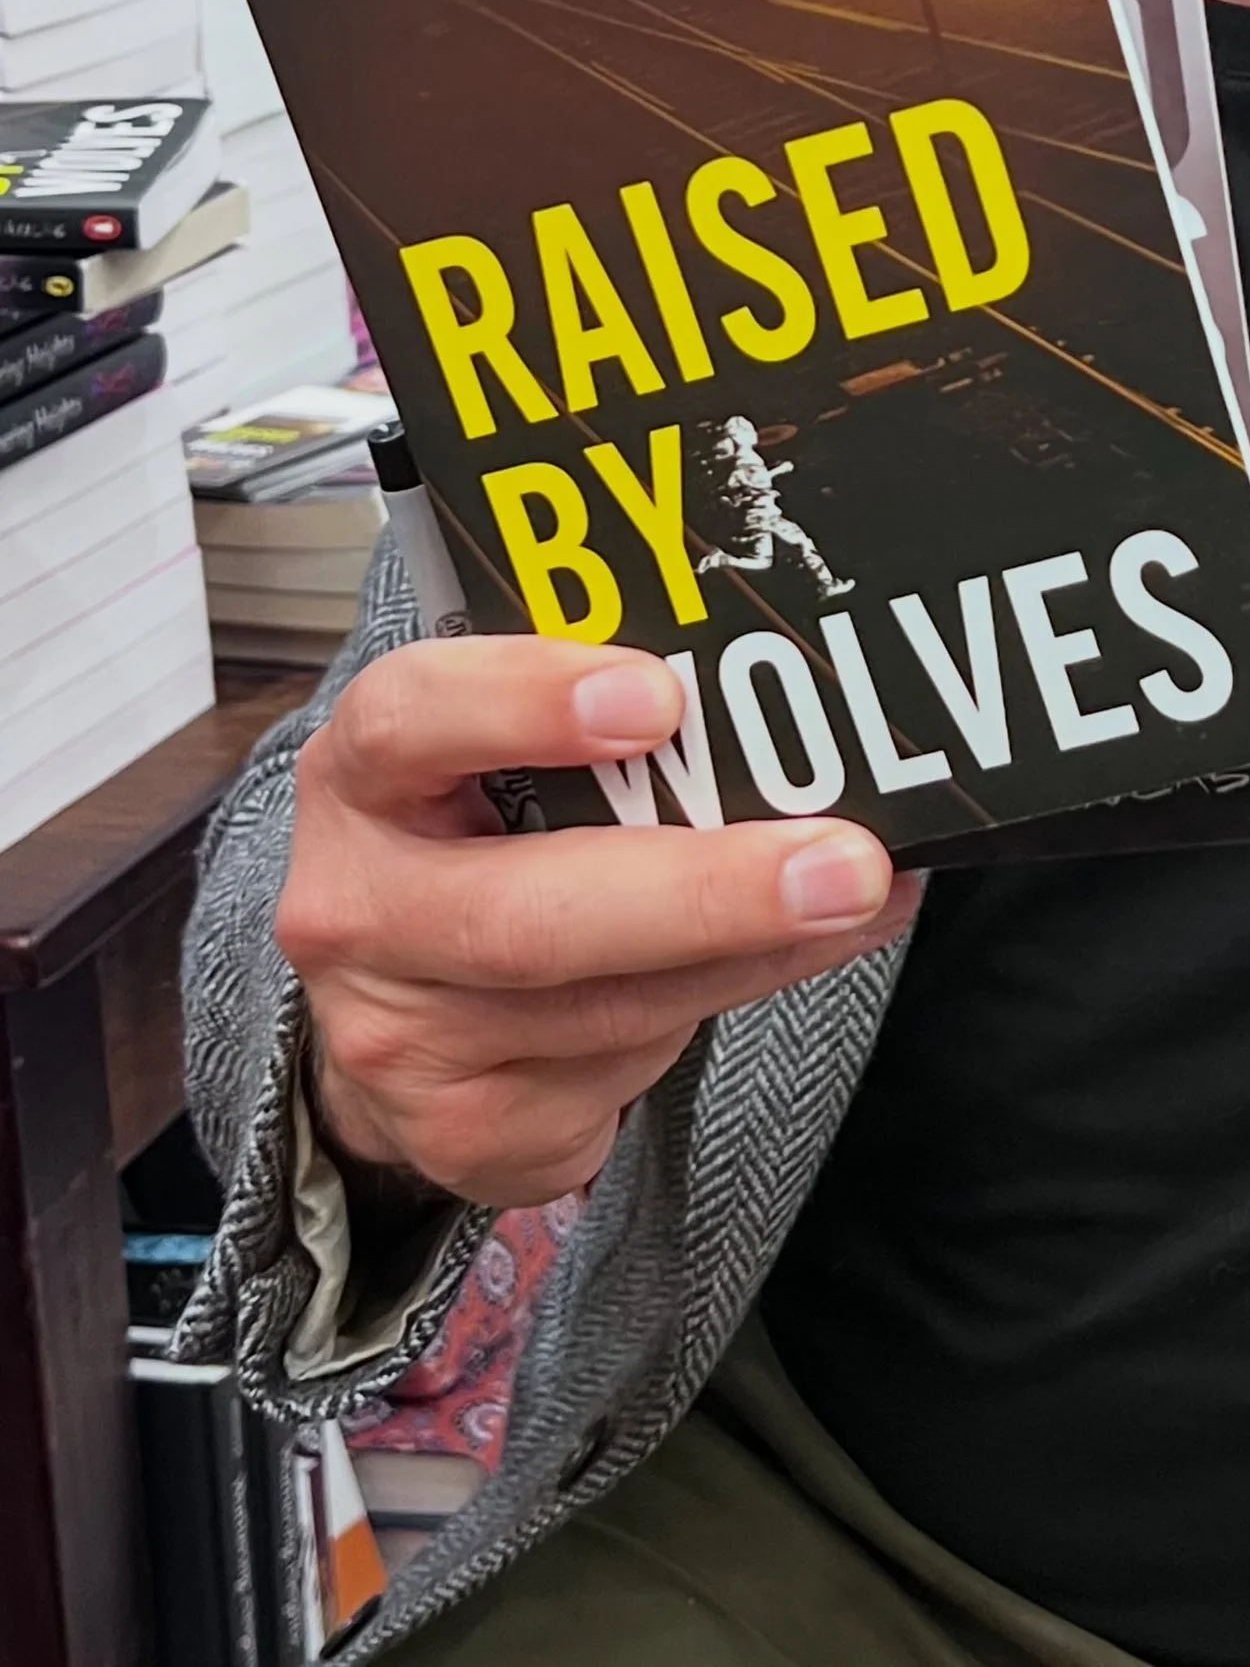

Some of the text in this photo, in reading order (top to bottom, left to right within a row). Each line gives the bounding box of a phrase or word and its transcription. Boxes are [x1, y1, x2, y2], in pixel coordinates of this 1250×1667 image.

[400, 98, 1030, 440] RAISED
[481, 425, 708, 646] BY
[590, 529, 1235, 830] WOLVES
